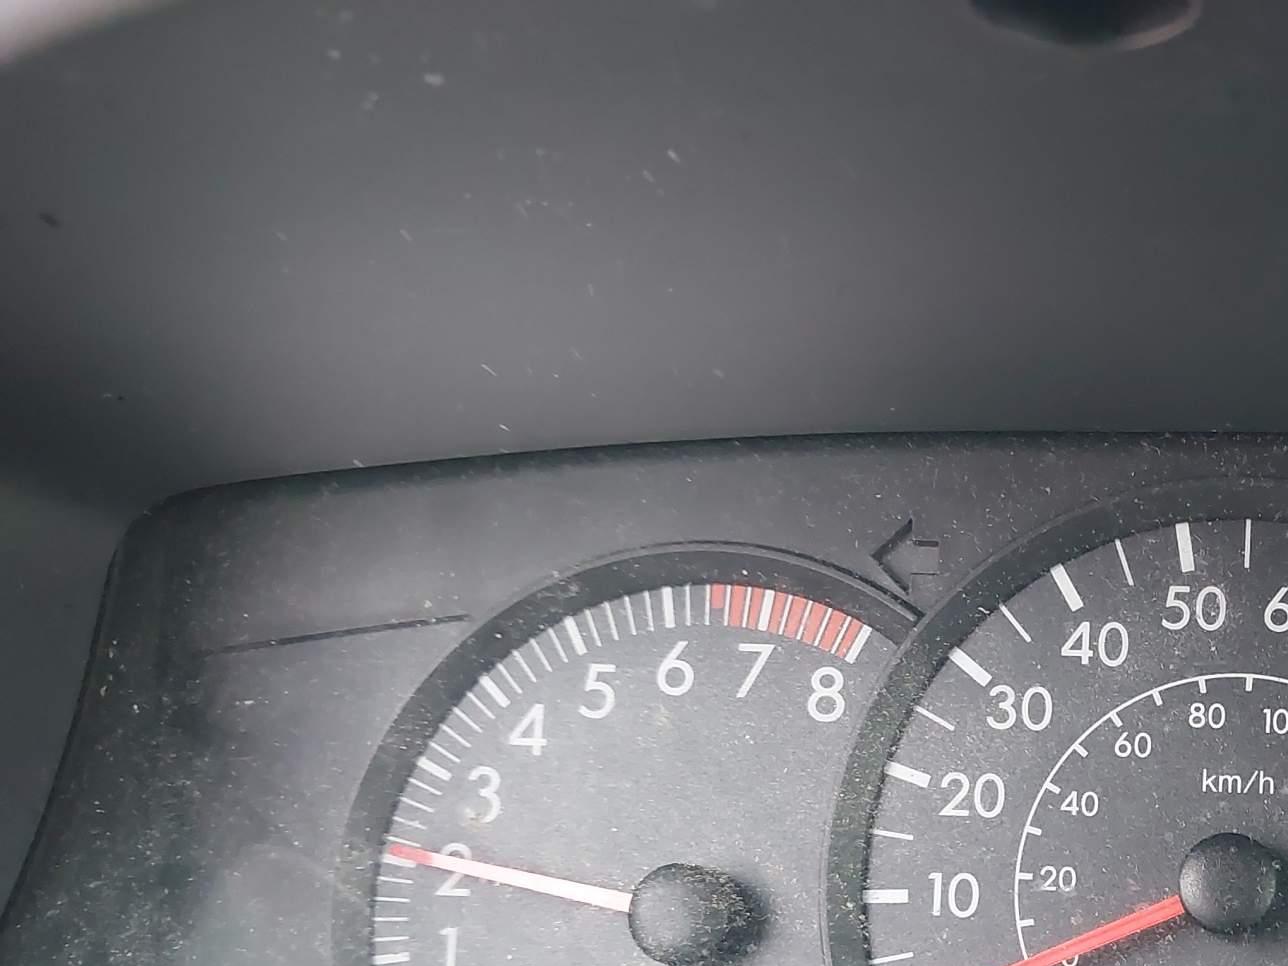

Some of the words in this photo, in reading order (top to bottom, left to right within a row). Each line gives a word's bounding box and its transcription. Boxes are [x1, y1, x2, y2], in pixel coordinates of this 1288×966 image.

[1162, 587, 1226, 632] 50
[1060, 621, 1129, 666] 40
[657, 641, 695, 695] 6
[736, 644, 776, 698] 7
[578, 664, 616, 719] 5
[808, 667, 845, 721] 8
[986, 686, 1053, 730] 30
[509, 705, 548, 755] 4
[1188, 703, 1226, 729] 80
[1114, 732, 1152, 759] 60
[468, 767, 501, 823] 3
[939, 774, 1005, 817] 20
[1202, 769, 1275, 795] km/h
[1061, 792, 1099, 817] 40
[928, 873, 979, 916] 10
[1040, 867, 1076, 892] 20
